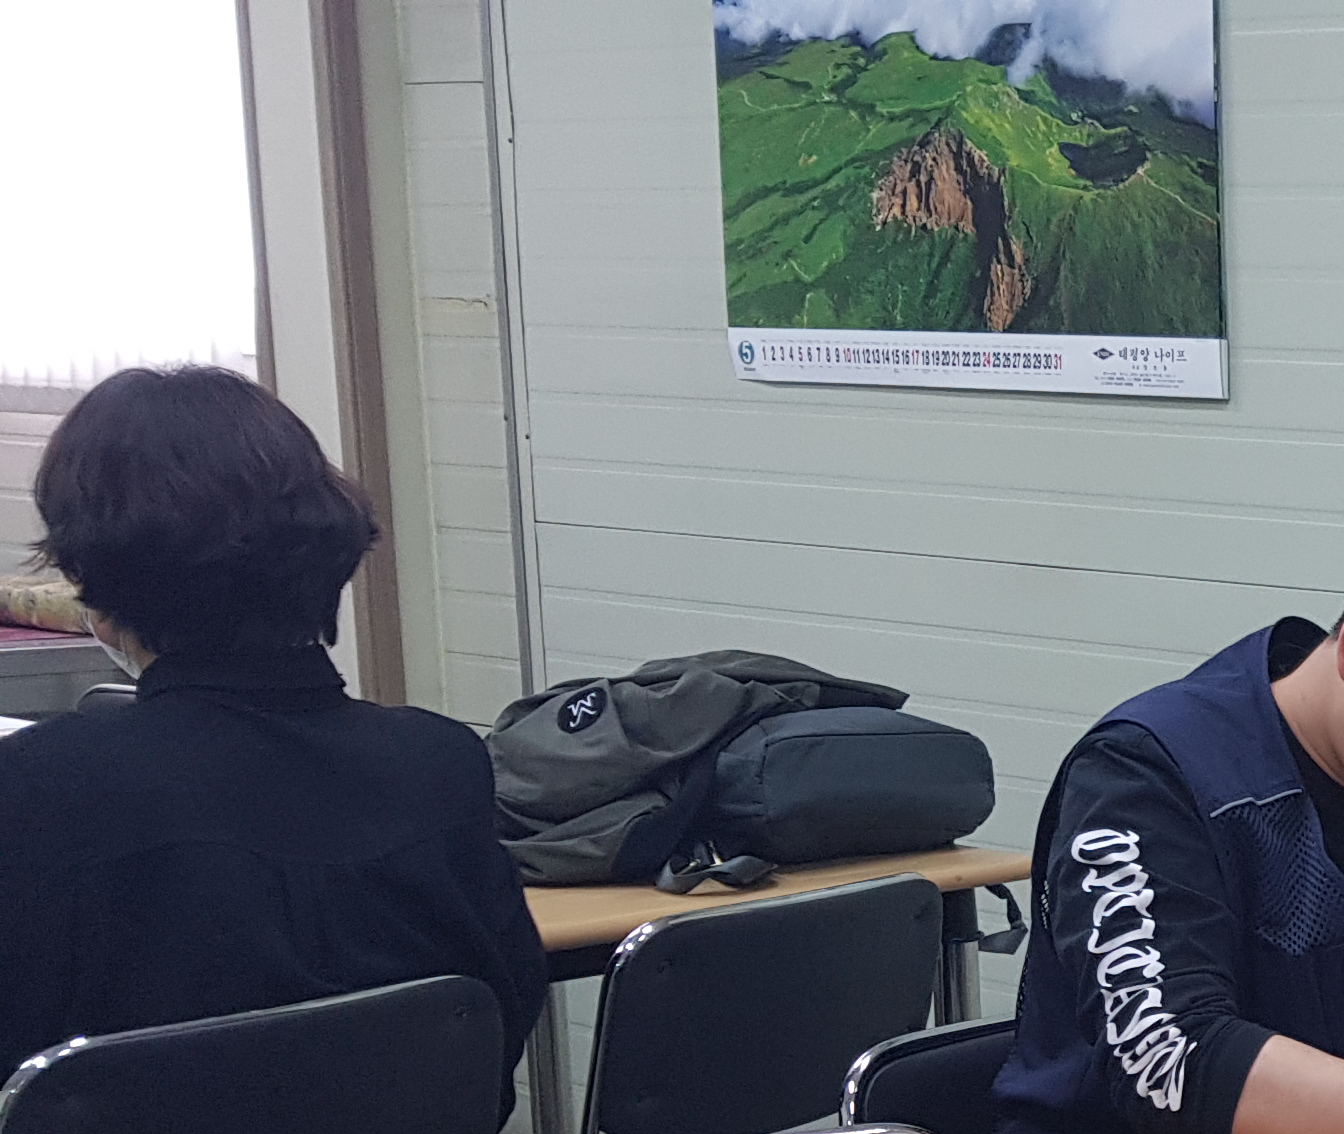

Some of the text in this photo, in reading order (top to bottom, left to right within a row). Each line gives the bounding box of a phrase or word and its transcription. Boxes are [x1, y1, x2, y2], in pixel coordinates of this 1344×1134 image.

[761, 346, 1062, 369] 1 2 3 4 5 6 7 8 9 10 11 12 13 14 15 16 17 18 19 20 21 22 23 24 25 26 27 28 29 30 31
[1154, 348, 1187, 363] 나이프
